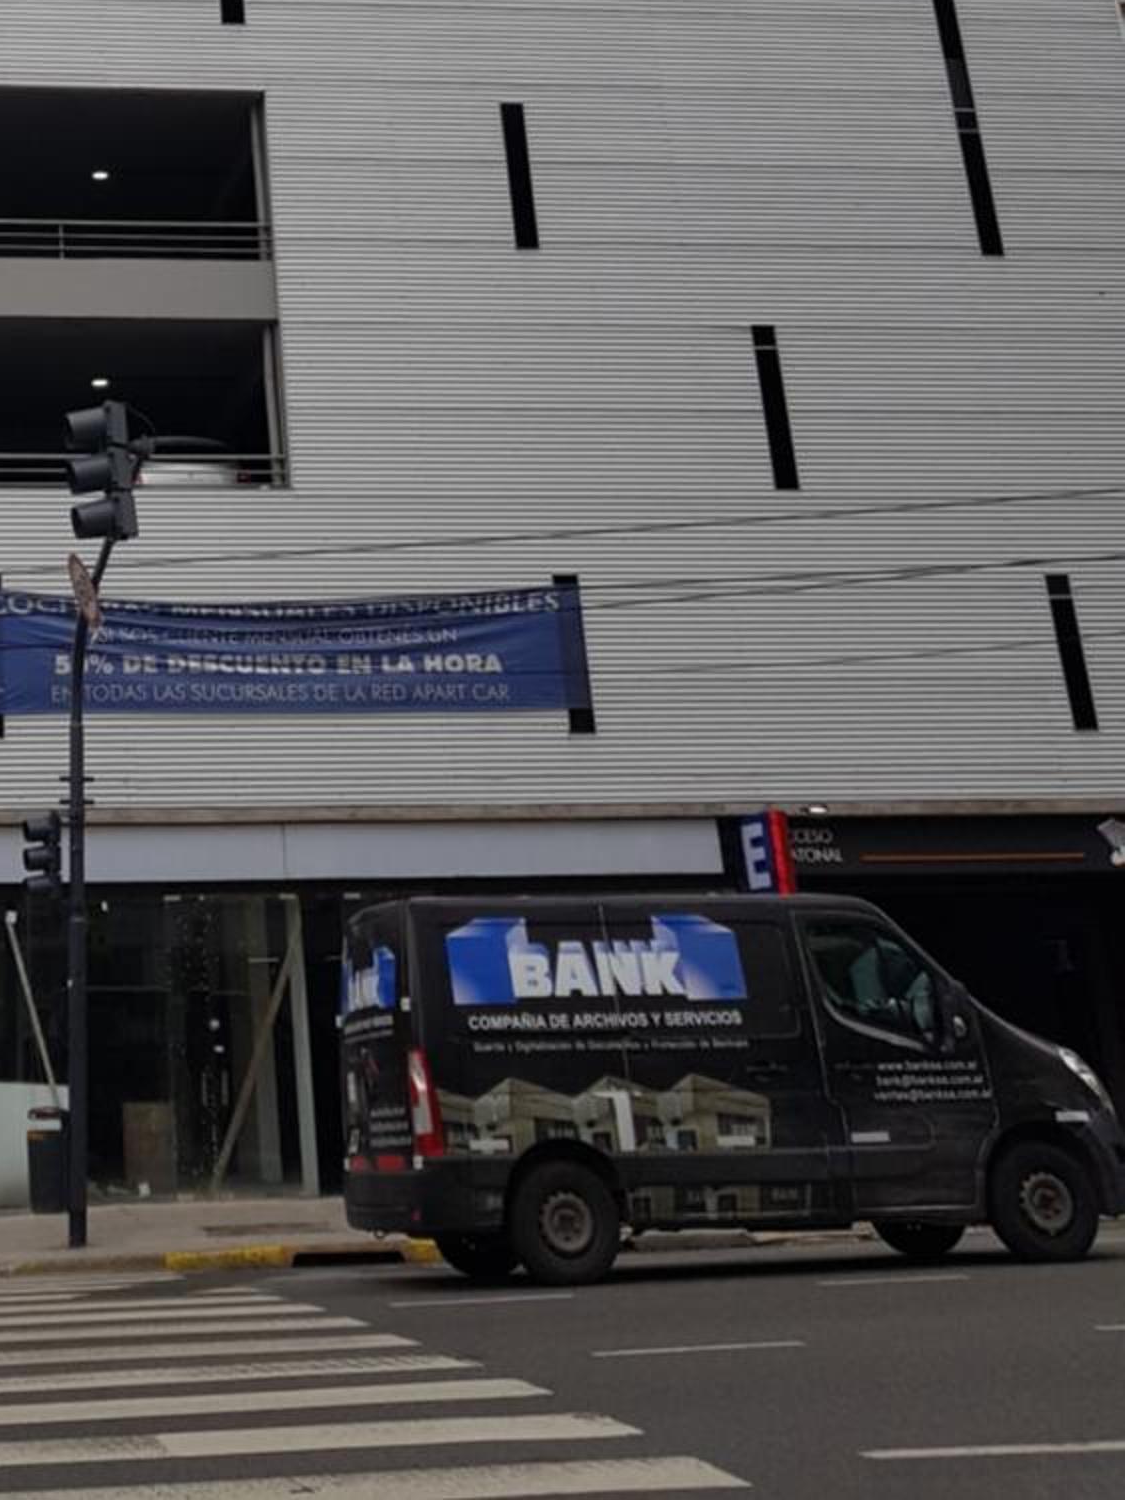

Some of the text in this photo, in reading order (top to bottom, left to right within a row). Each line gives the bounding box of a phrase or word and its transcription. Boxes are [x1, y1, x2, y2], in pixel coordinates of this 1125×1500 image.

[426, 628, 458, 643] UN
[54, 653, 503, 676] 5% DE DESCUENTO EN LA HORA
[84, 683, 148, 703] TODAS
[153, 683, 187, 702] LAS
[190, 683, 308, 702] SUCURSALES
[313, 684, 337, 702] DE
[345, 684, 366, 702] LA
[371, 684, 408, 702] RED
[412, 683, 469, 702] APART
[472, 684, 512, 702] CAR
[740, 821, 772, 891] E
[507, 940, 687, 999] BANK
[549, 1013, 572, 1029] DE
[572, 1012, 649, 1029] ARCHIVOS
[650, 1011, 663, 1027] Y
[664, 1010, 743, 1027] SERVICIOS
